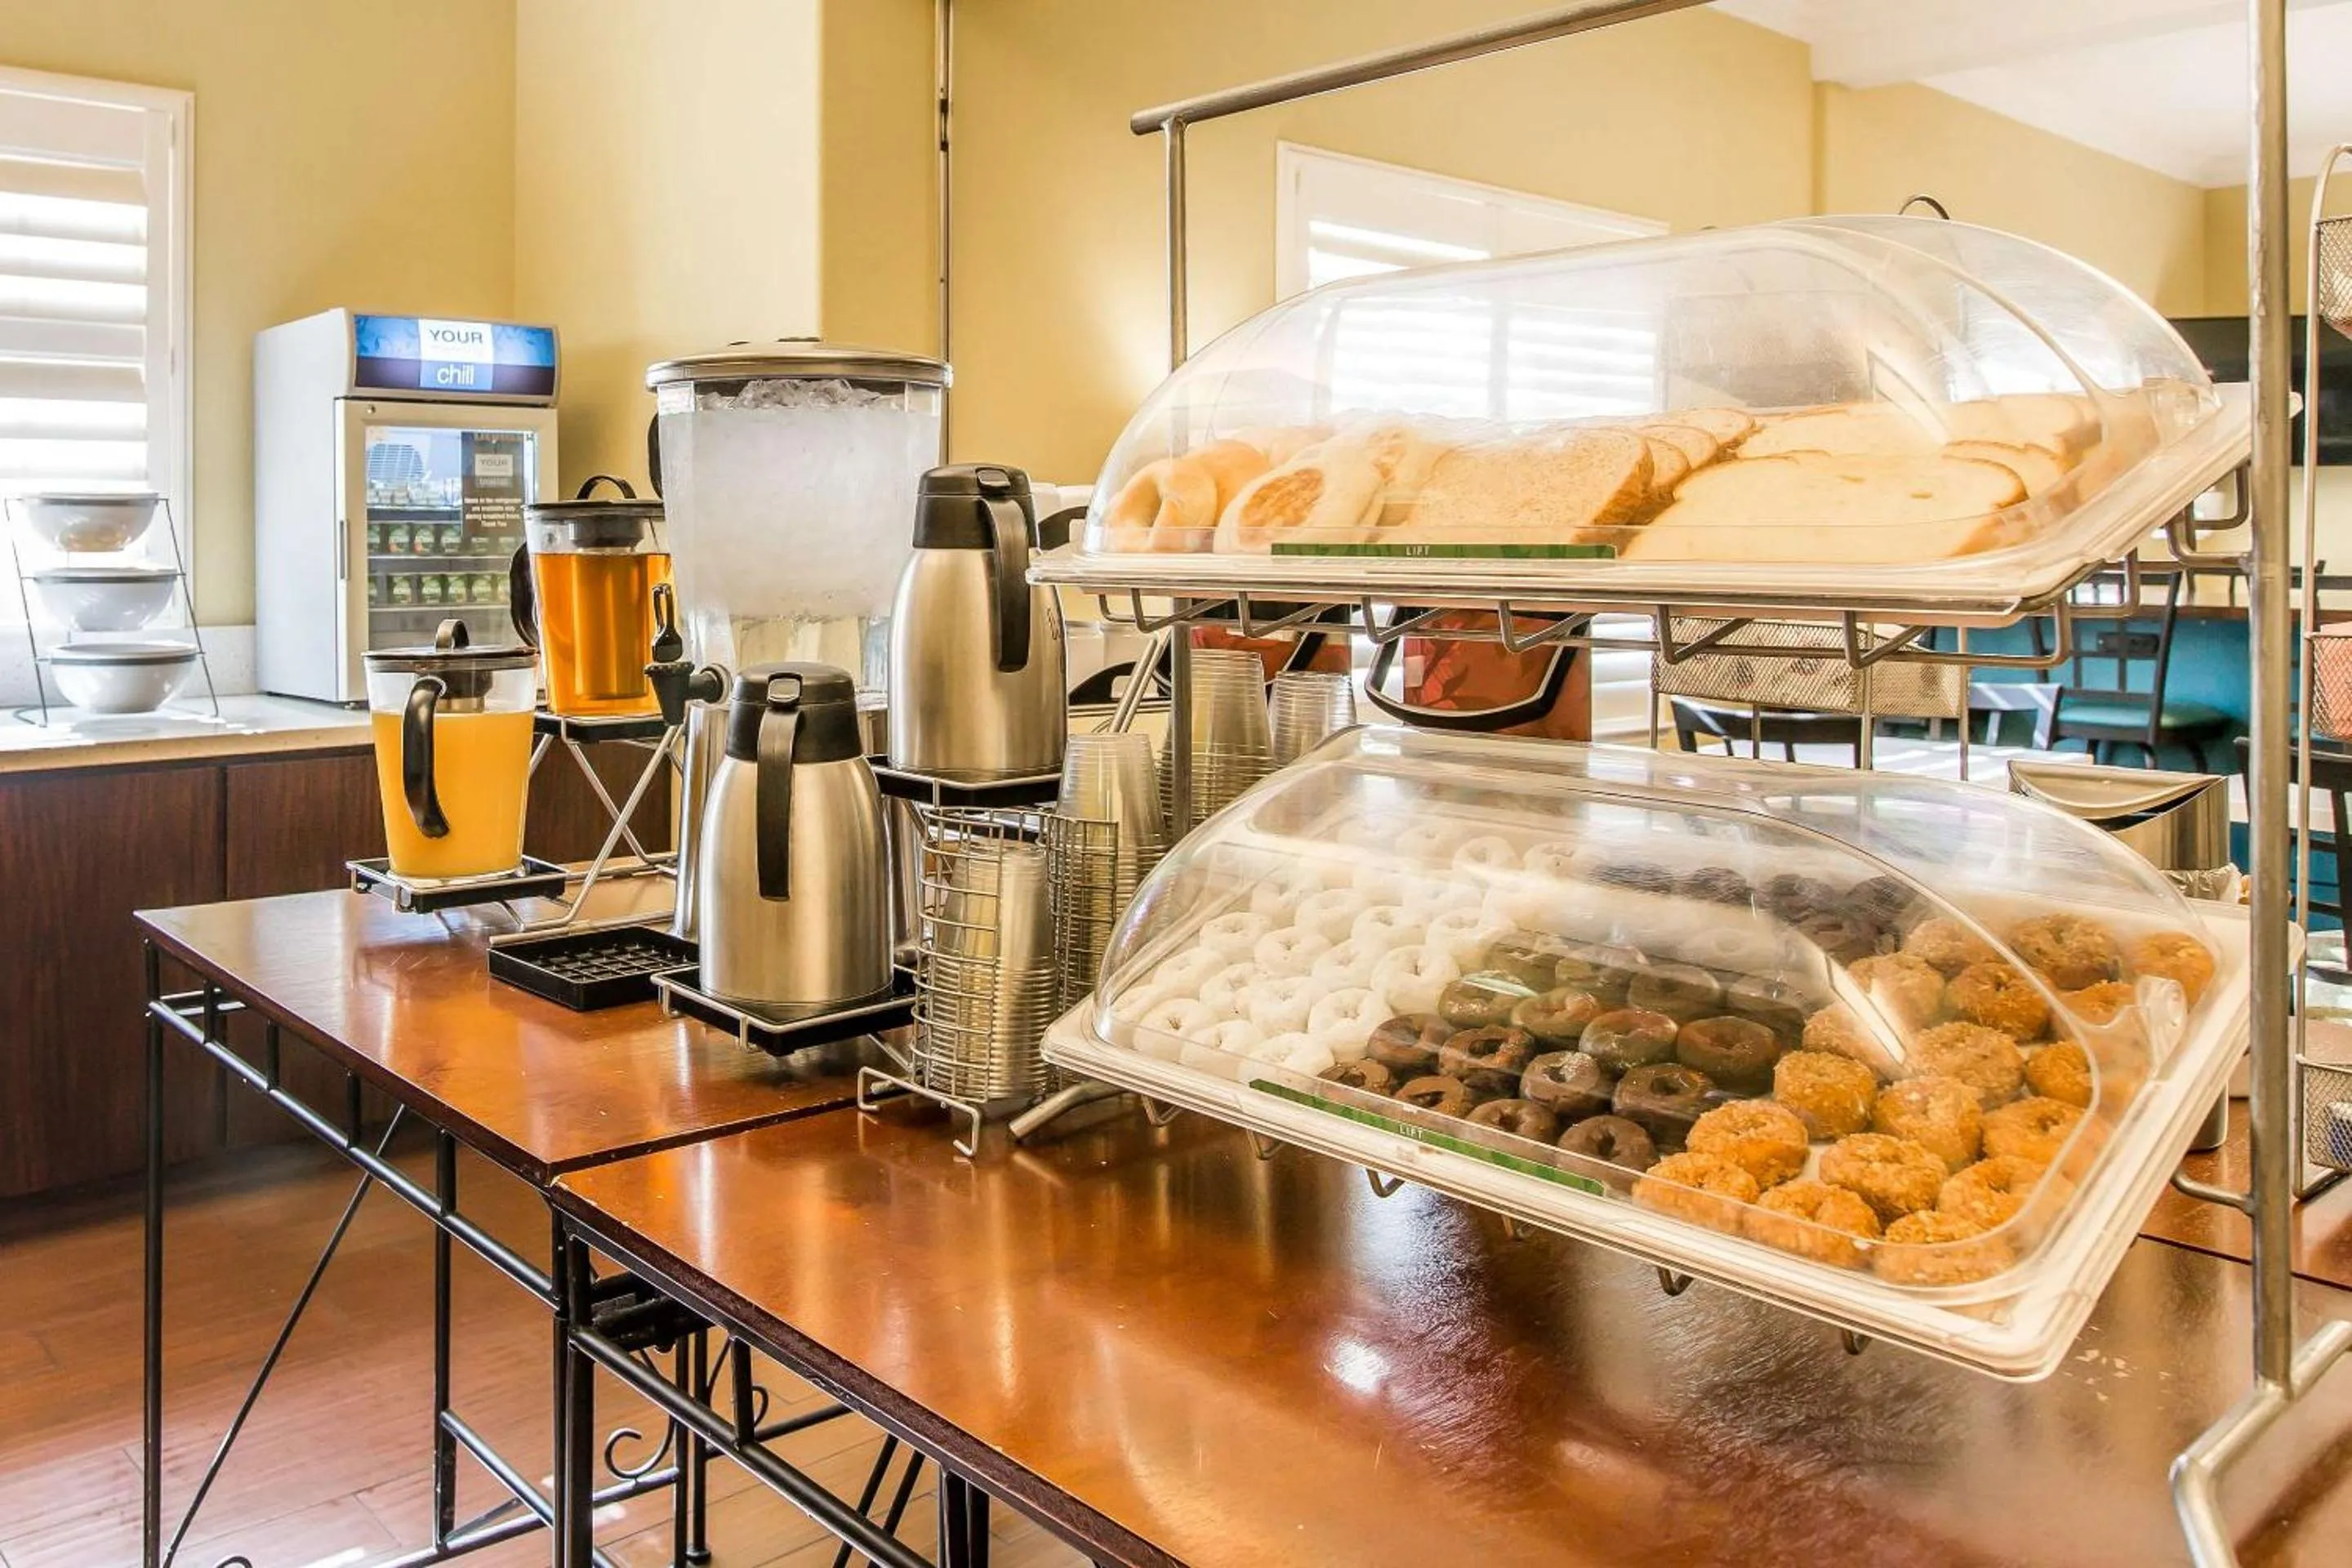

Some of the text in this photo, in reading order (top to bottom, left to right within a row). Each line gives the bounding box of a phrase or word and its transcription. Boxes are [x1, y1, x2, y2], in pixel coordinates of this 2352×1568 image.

[430, 329, 483, 344] YOUR
[437, 363, 474, 385] chill
[1405, 545, 1430, 556] LIFT
[1399, 1123, 1423, 1140] LIFT
